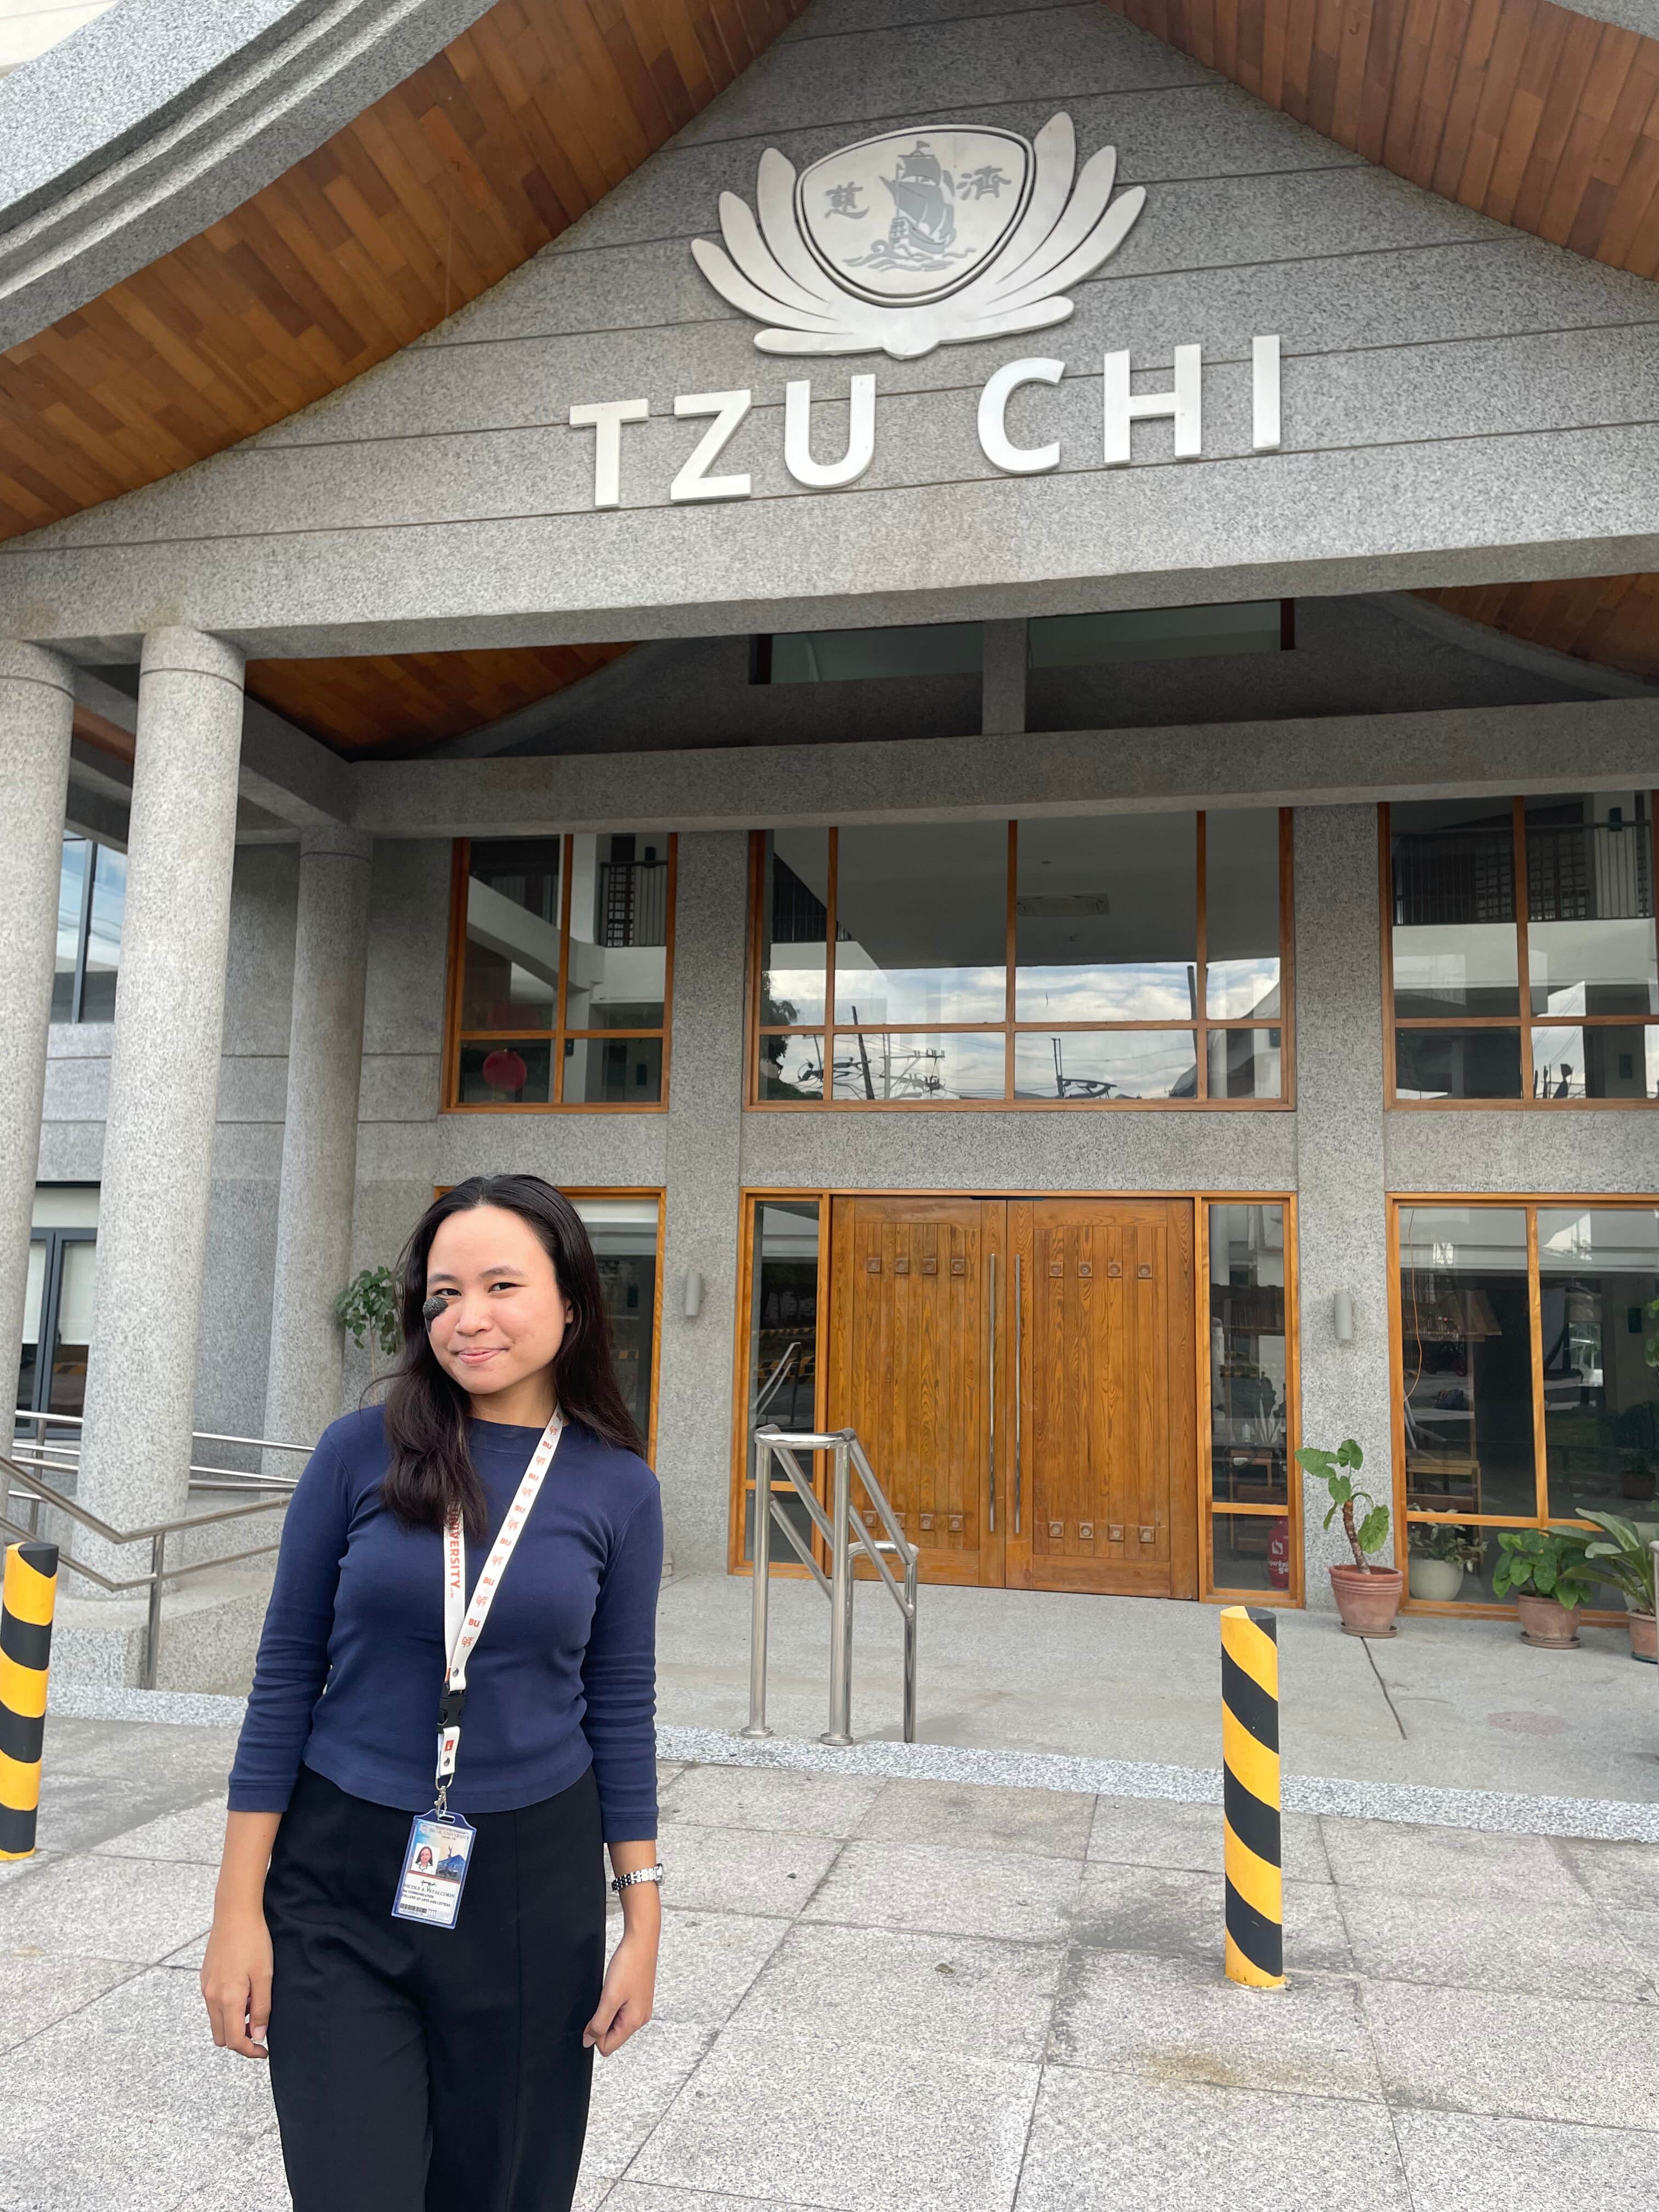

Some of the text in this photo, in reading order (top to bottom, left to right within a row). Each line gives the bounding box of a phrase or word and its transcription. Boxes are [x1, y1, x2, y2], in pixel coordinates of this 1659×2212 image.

[824, 182, 870, 219] 慈
[569, 335, 1280, 509] TZU CHI
[542, 1441, 553, 1449] BU
[528, 1472, 539, 1481] BU
[515, 1505, 526, 1514] BU
[500, 1538, 512, 1547] BU
[483, 1577, 495, 1585] BU
[468, 1618, 481, 1627] BU
